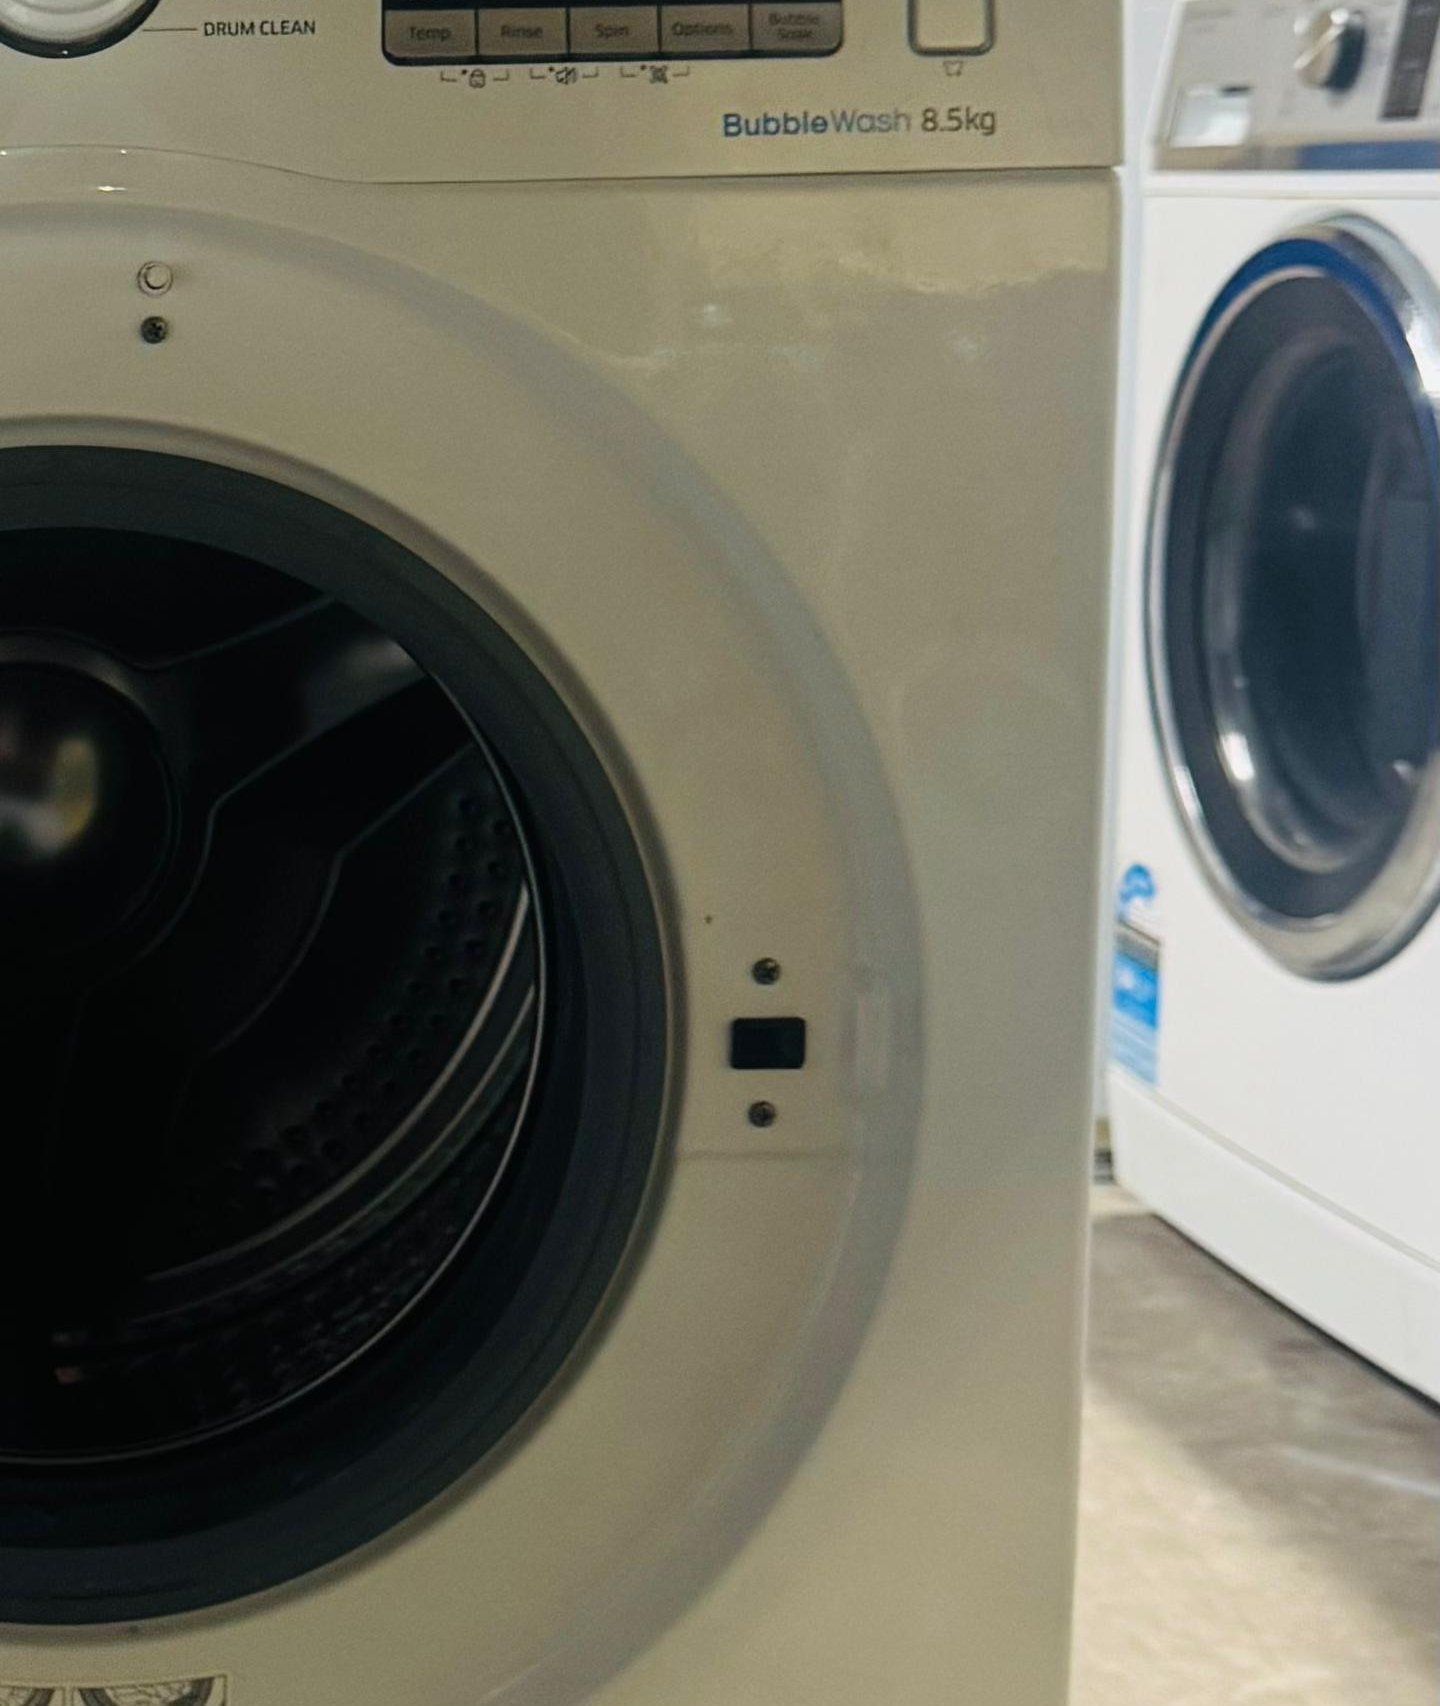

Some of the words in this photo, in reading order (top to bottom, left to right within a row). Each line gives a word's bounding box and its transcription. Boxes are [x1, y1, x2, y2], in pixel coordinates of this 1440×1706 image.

[203, 21, 256, 37] DRUM
[259, 19, 316, 36] CLEAN
[408, 25, 452, 43] Temp
[500, 24, 544, 40] Rinse
[593, 23, 630, 41] Spin
[670, 21, 734, 39] Options
[920, 106, 997, 137] 8.5kg
